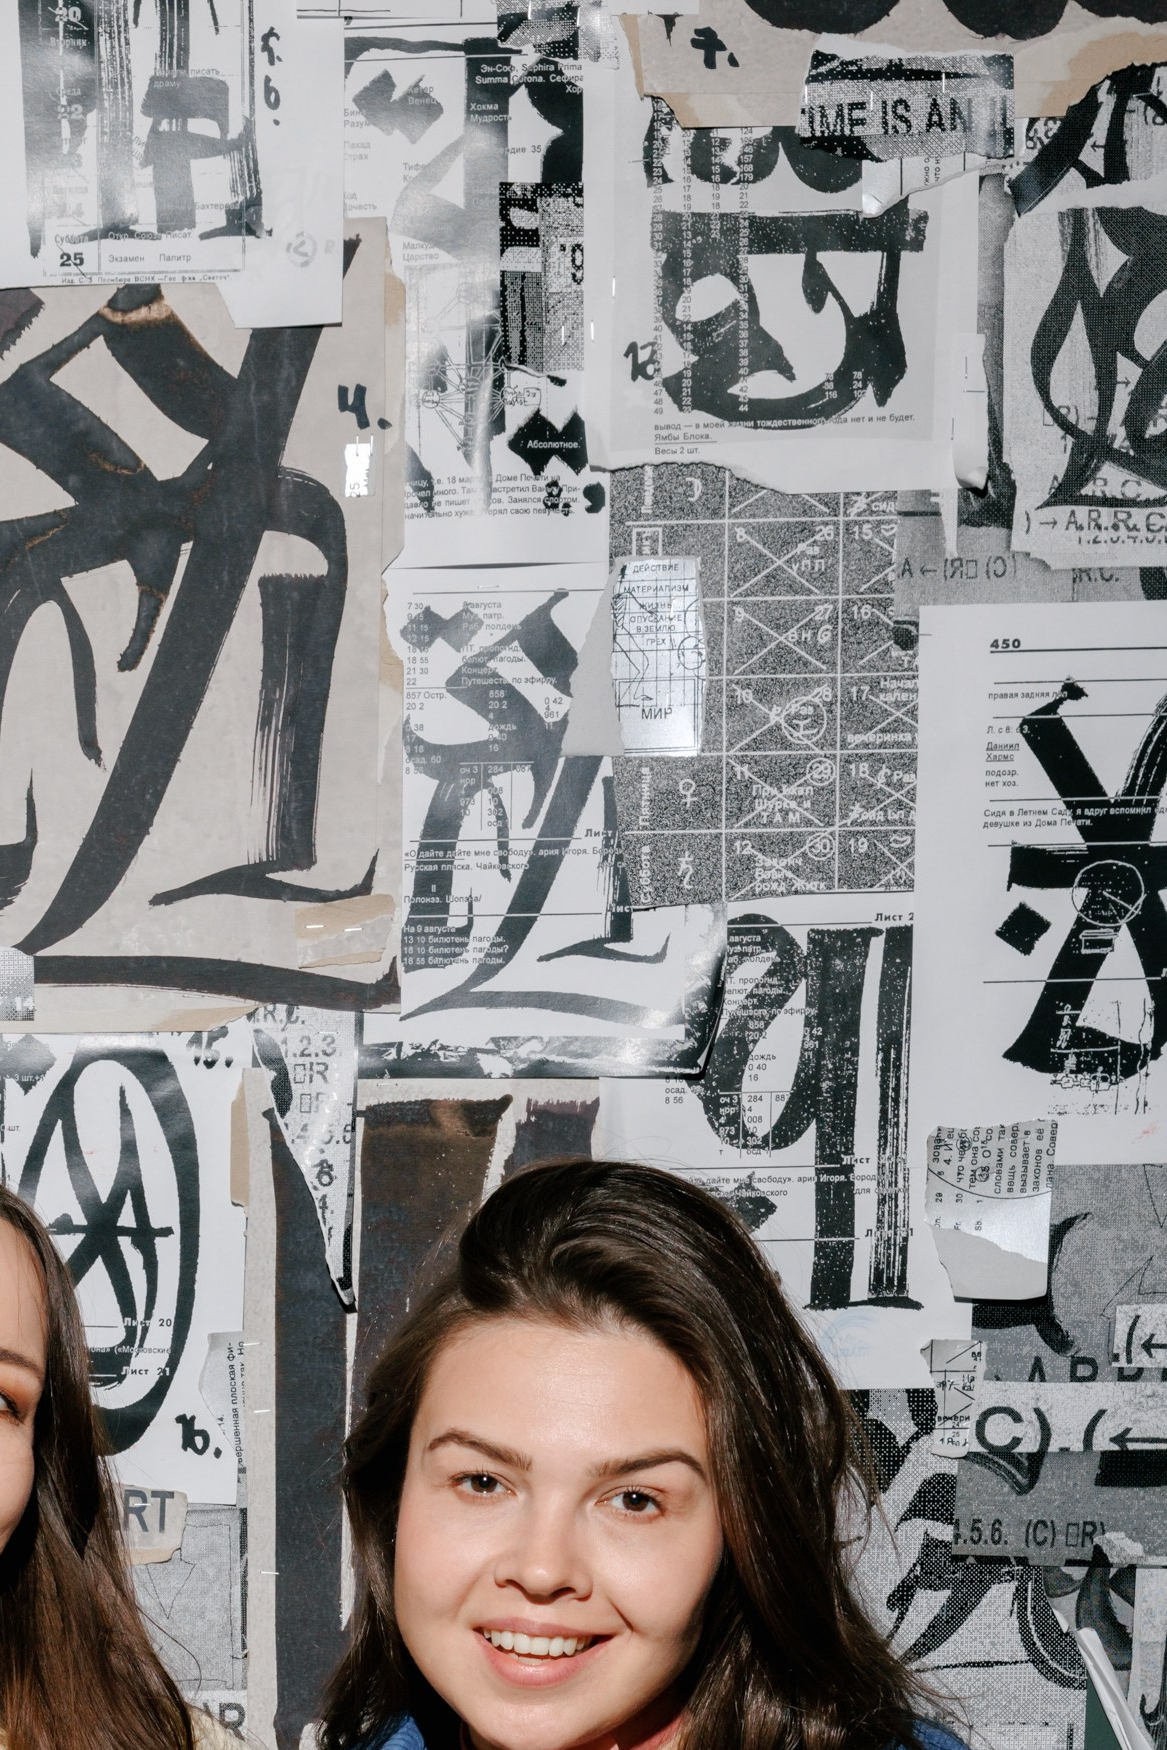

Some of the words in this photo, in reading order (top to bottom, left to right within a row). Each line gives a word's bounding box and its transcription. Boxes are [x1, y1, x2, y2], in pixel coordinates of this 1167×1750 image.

[59, 252, 84, 267] 25
[633, 564, 679, 573] ДЕЙСТВИЕ
[990, 639, 1021, 649] 450
[989, 692, 1018, 700] правая
[1021, 691, 1049, 699] задняя
[641, 707, 672, 721] МИР
[986, 742, 1020, 751] Даниил
[986, 753, 1014, 761] Хармс
[984, 809, 1006, 818] Сидя
[1018, 809, 1048, 817] Летнем
[1084, 808, 1107, 816] вдруг
[983, 820, 1020, 829] девушке
[1035, 819, 1057, 827] Дома
[404, 863, 438, 872] Русская
[875, 913, 904, 922] Лист
[749, 1053, 776, 1062] дождь
[124, 1318, 151, 1326] Лист
[159, 1318, 172, 1327] 20
[121, 1367, 149, 1375] Лист
[157, 1367, 170, 1376] 21
